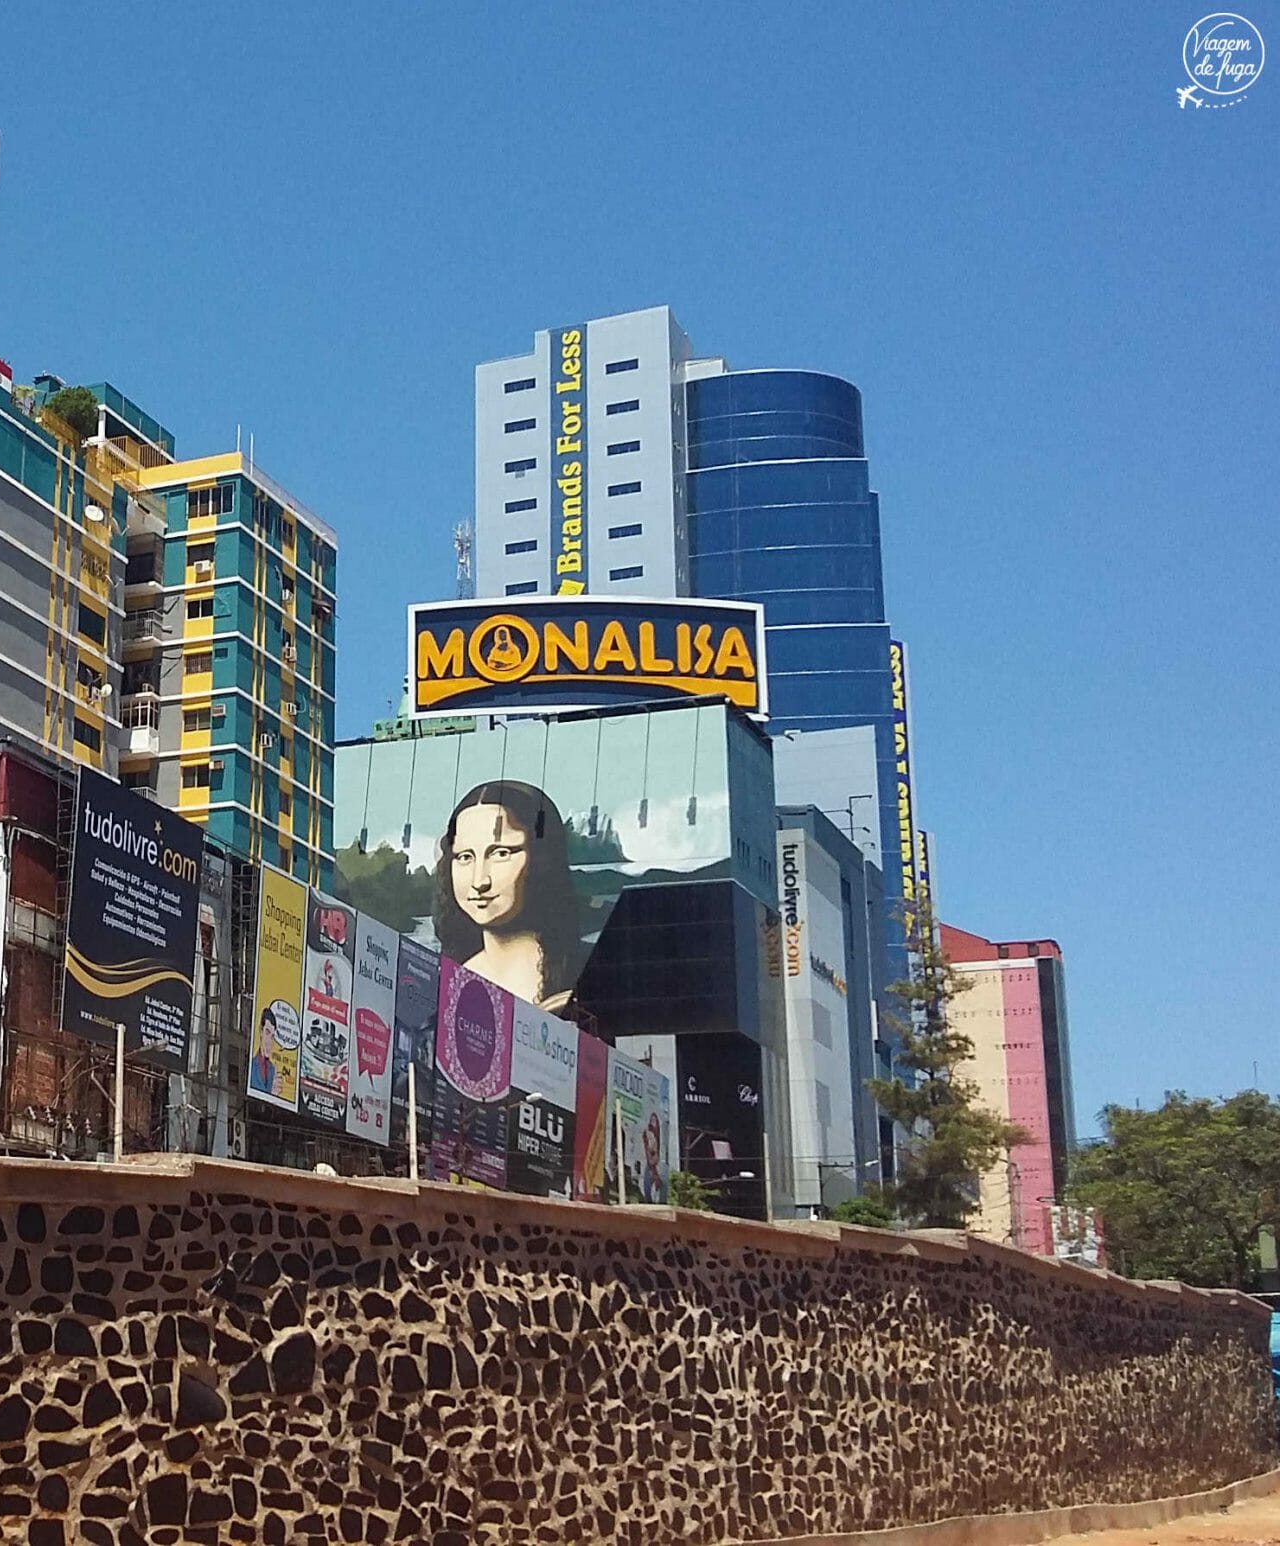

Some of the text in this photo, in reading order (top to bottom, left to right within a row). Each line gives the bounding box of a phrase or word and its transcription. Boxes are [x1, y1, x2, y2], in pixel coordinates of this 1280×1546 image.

[556, 329, 582, 576] Brands For Less
[417, 613, 756, 683] MONALISA
[84, 801, 197, 885] tudolivre.com
[265, 894, 302, 937] Shopping
